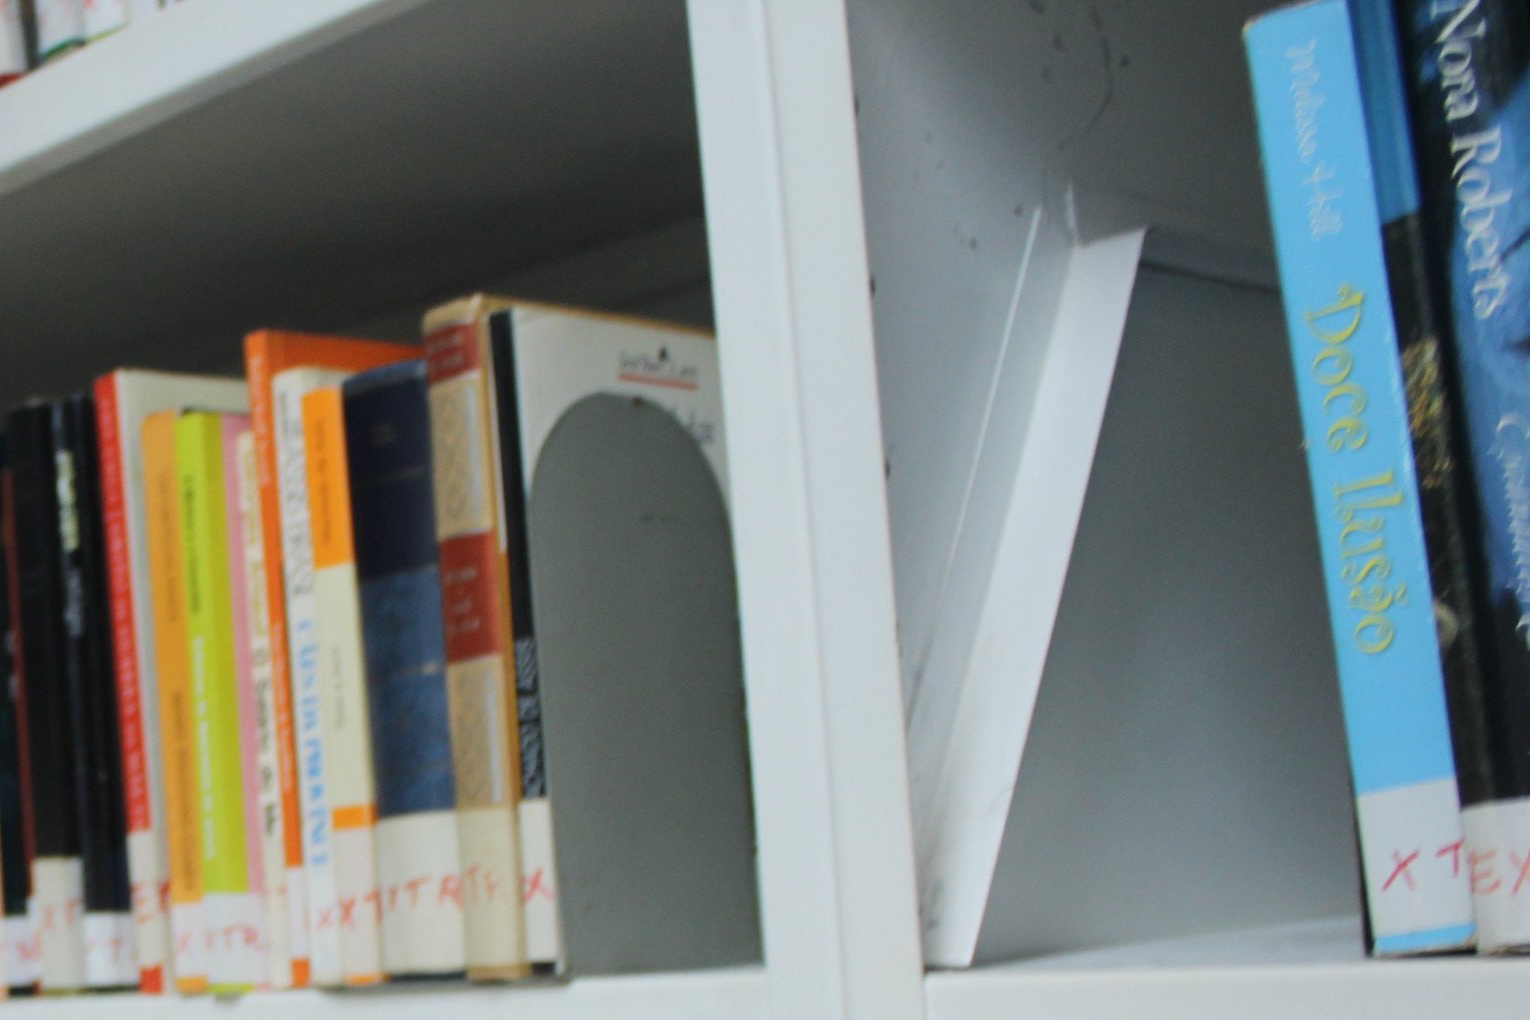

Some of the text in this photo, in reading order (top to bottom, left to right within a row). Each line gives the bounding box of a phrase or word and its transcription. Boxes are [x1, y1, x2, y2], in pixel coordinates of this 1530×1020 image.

[1430, 0, 1514, 320] Nora Roberts
[1303, 280, 1408, 655] Doce Ilusão
